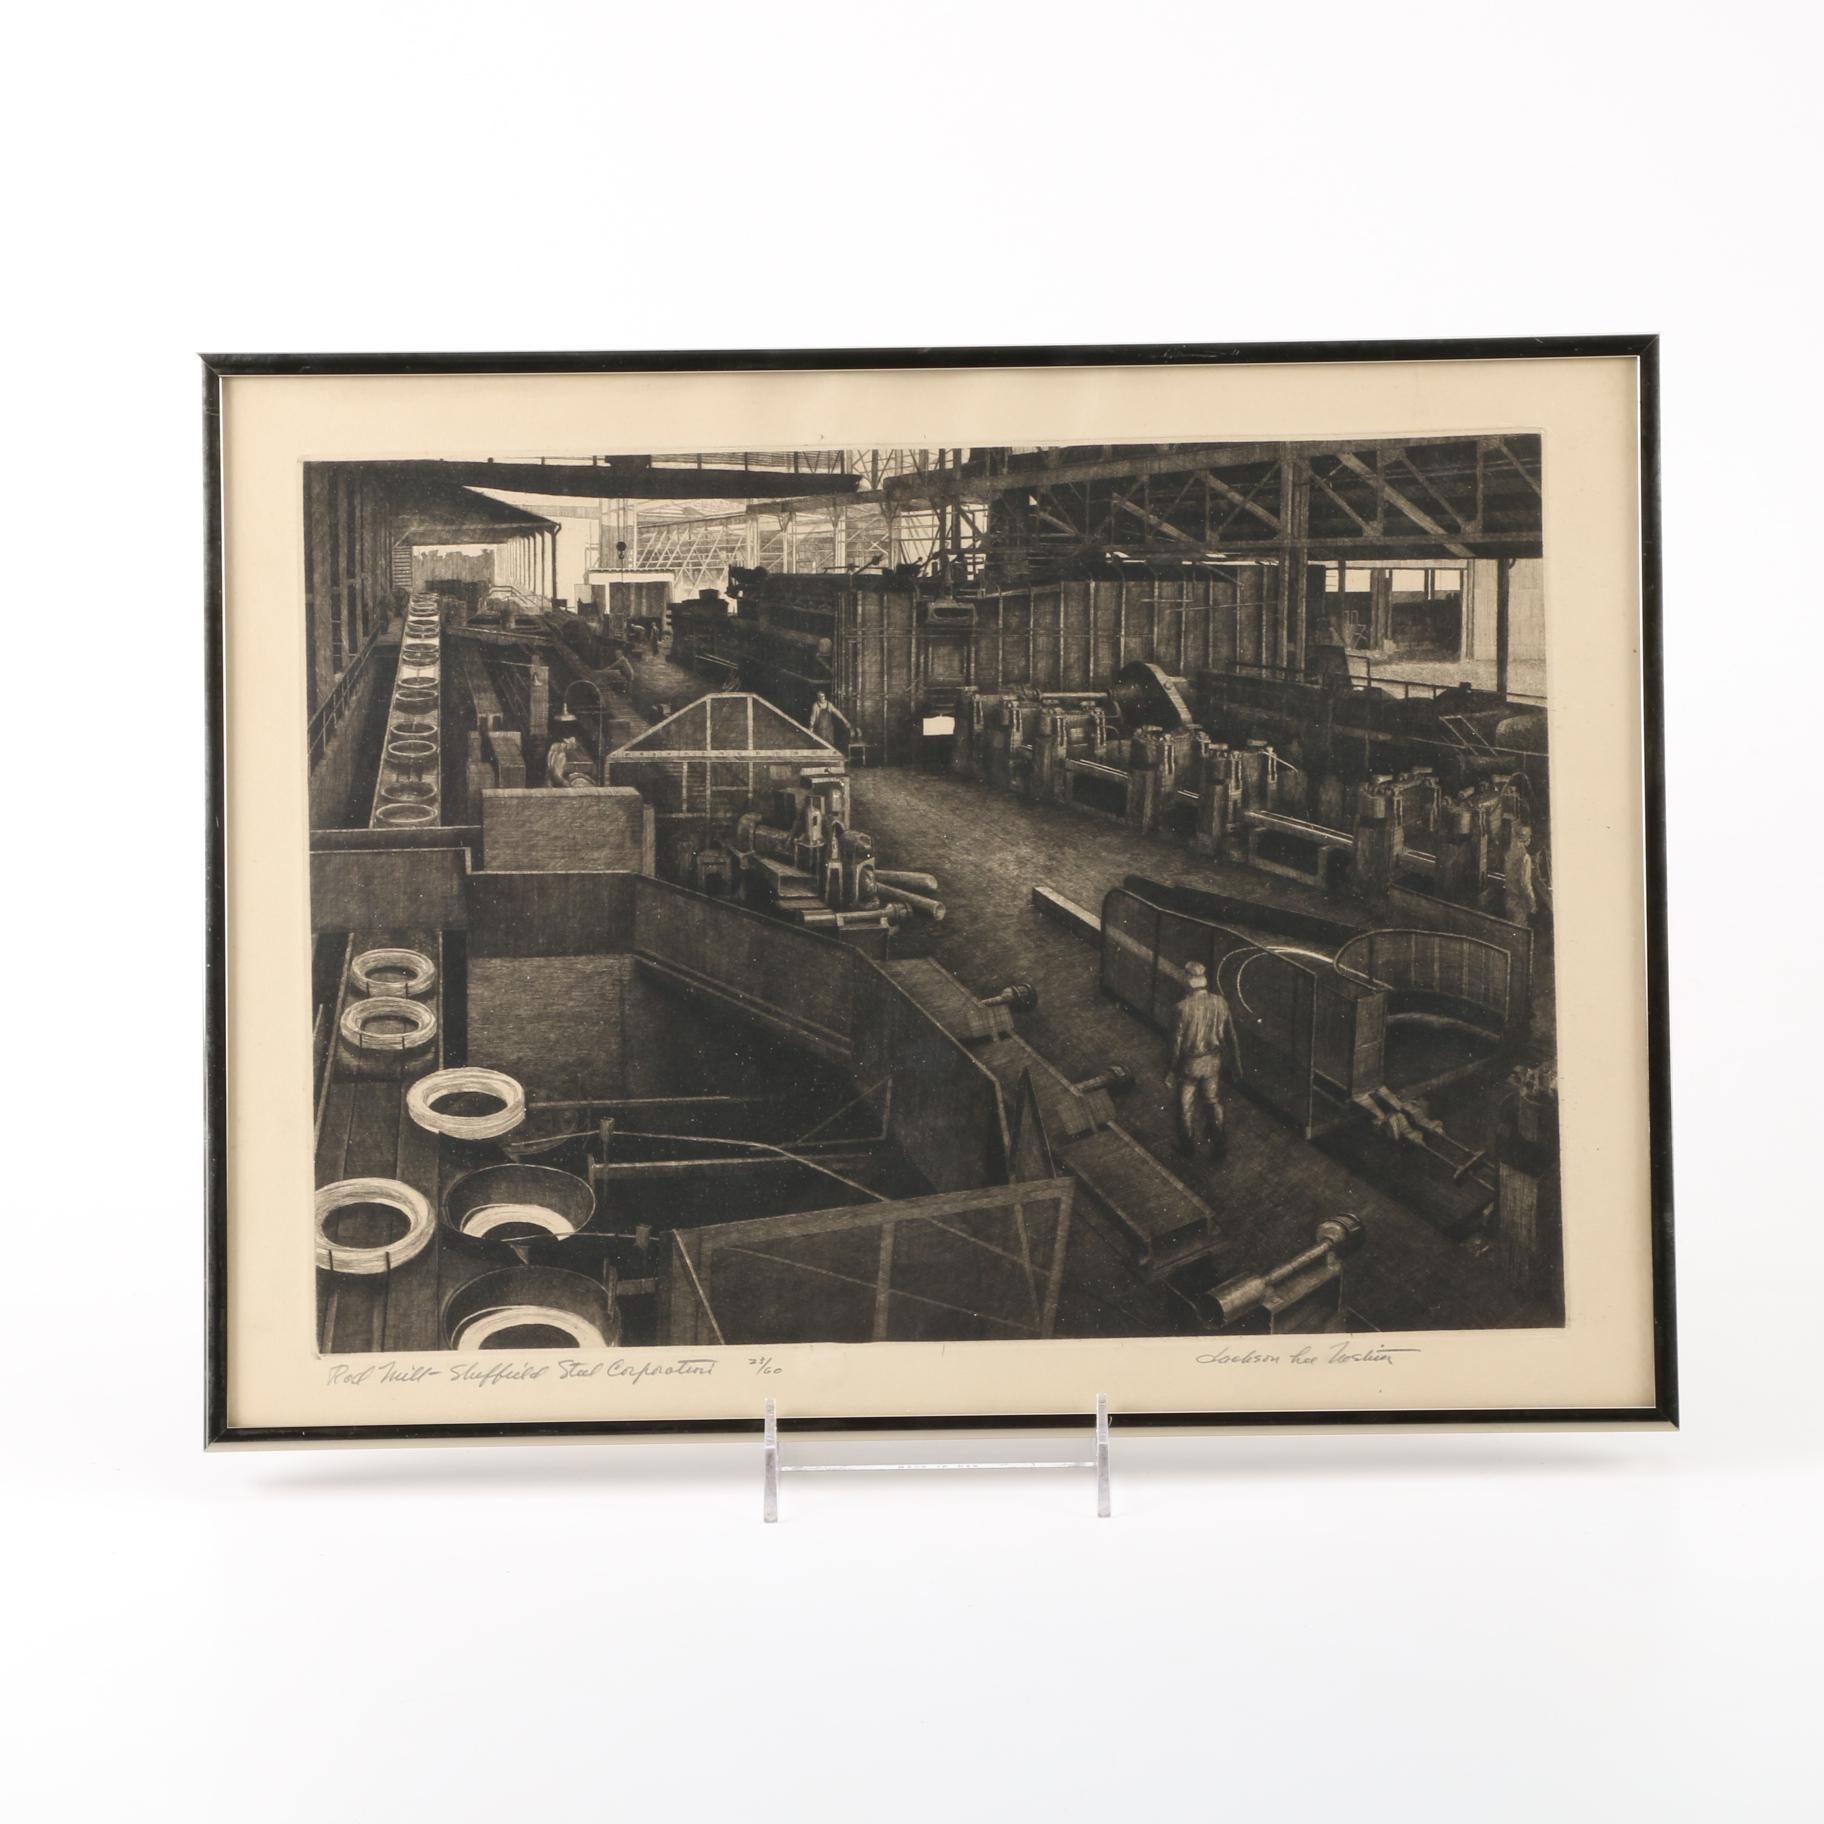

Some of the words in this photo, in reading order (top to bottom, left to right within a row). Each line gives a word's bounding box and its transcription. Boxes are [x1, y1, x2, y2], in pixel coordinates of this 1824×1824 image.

[326, 1364, 374, 1386] Rod
[557, 1359, 601, 1380] Steel
[606, 1359, 718, 1385] Corporation
